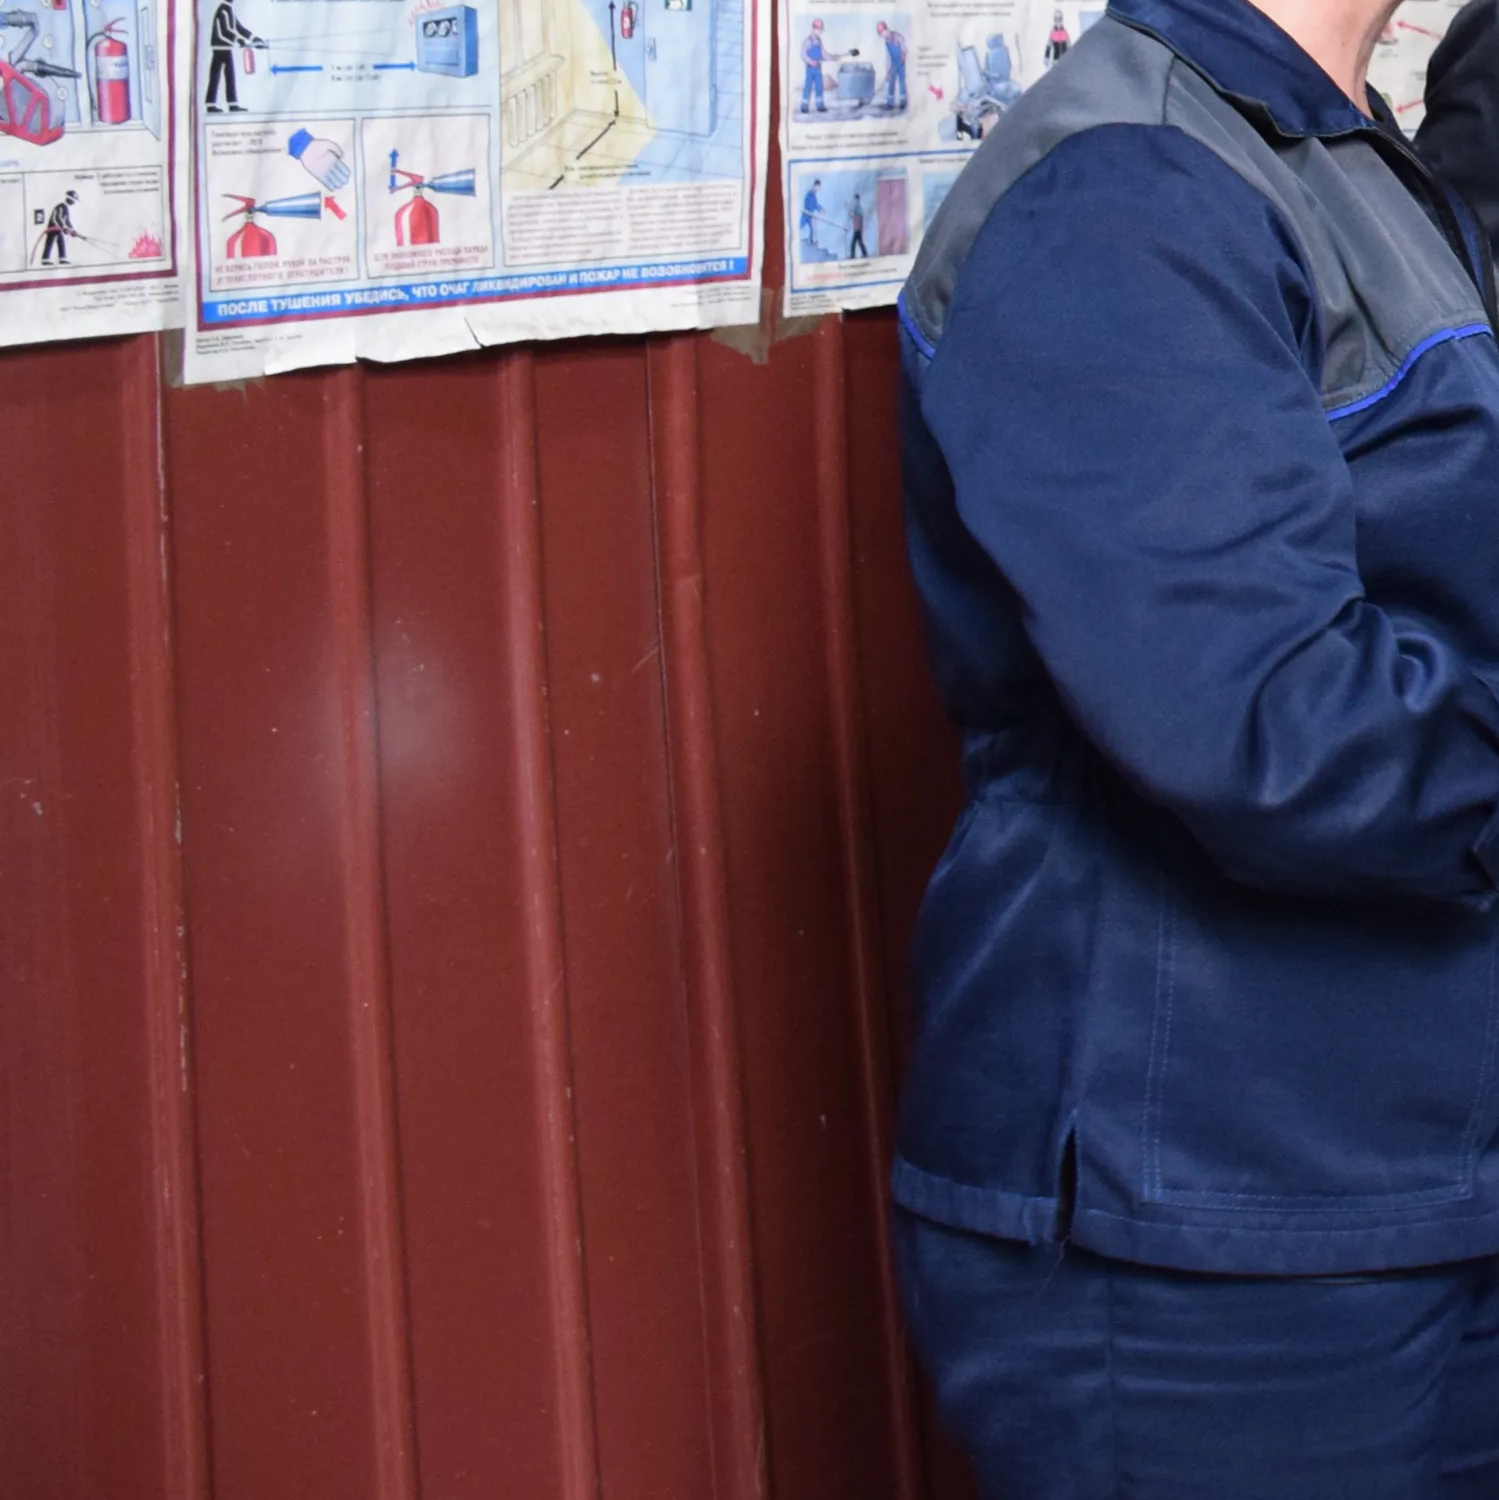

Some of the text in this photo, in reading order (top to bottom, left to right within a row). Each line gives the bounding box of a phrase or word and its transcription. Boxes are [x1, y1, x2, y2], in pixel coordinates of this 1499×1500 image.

[217, 300, 269, 316] ПОСЛЕ
[270, 293, 342, 311] ТУШЕНИЯ
[345, 286, 409, 304] УБЕДИСЬ,
[412, 285, 438, 298] ЧТО
[439, 283, 470, 297] ОЧАГ
[472, 275, 567, 293] ЛИКВИДИРОВАН
[579, 269, 620, 284] ПОЖАР
[622, 266, 638, 279] НЕ
